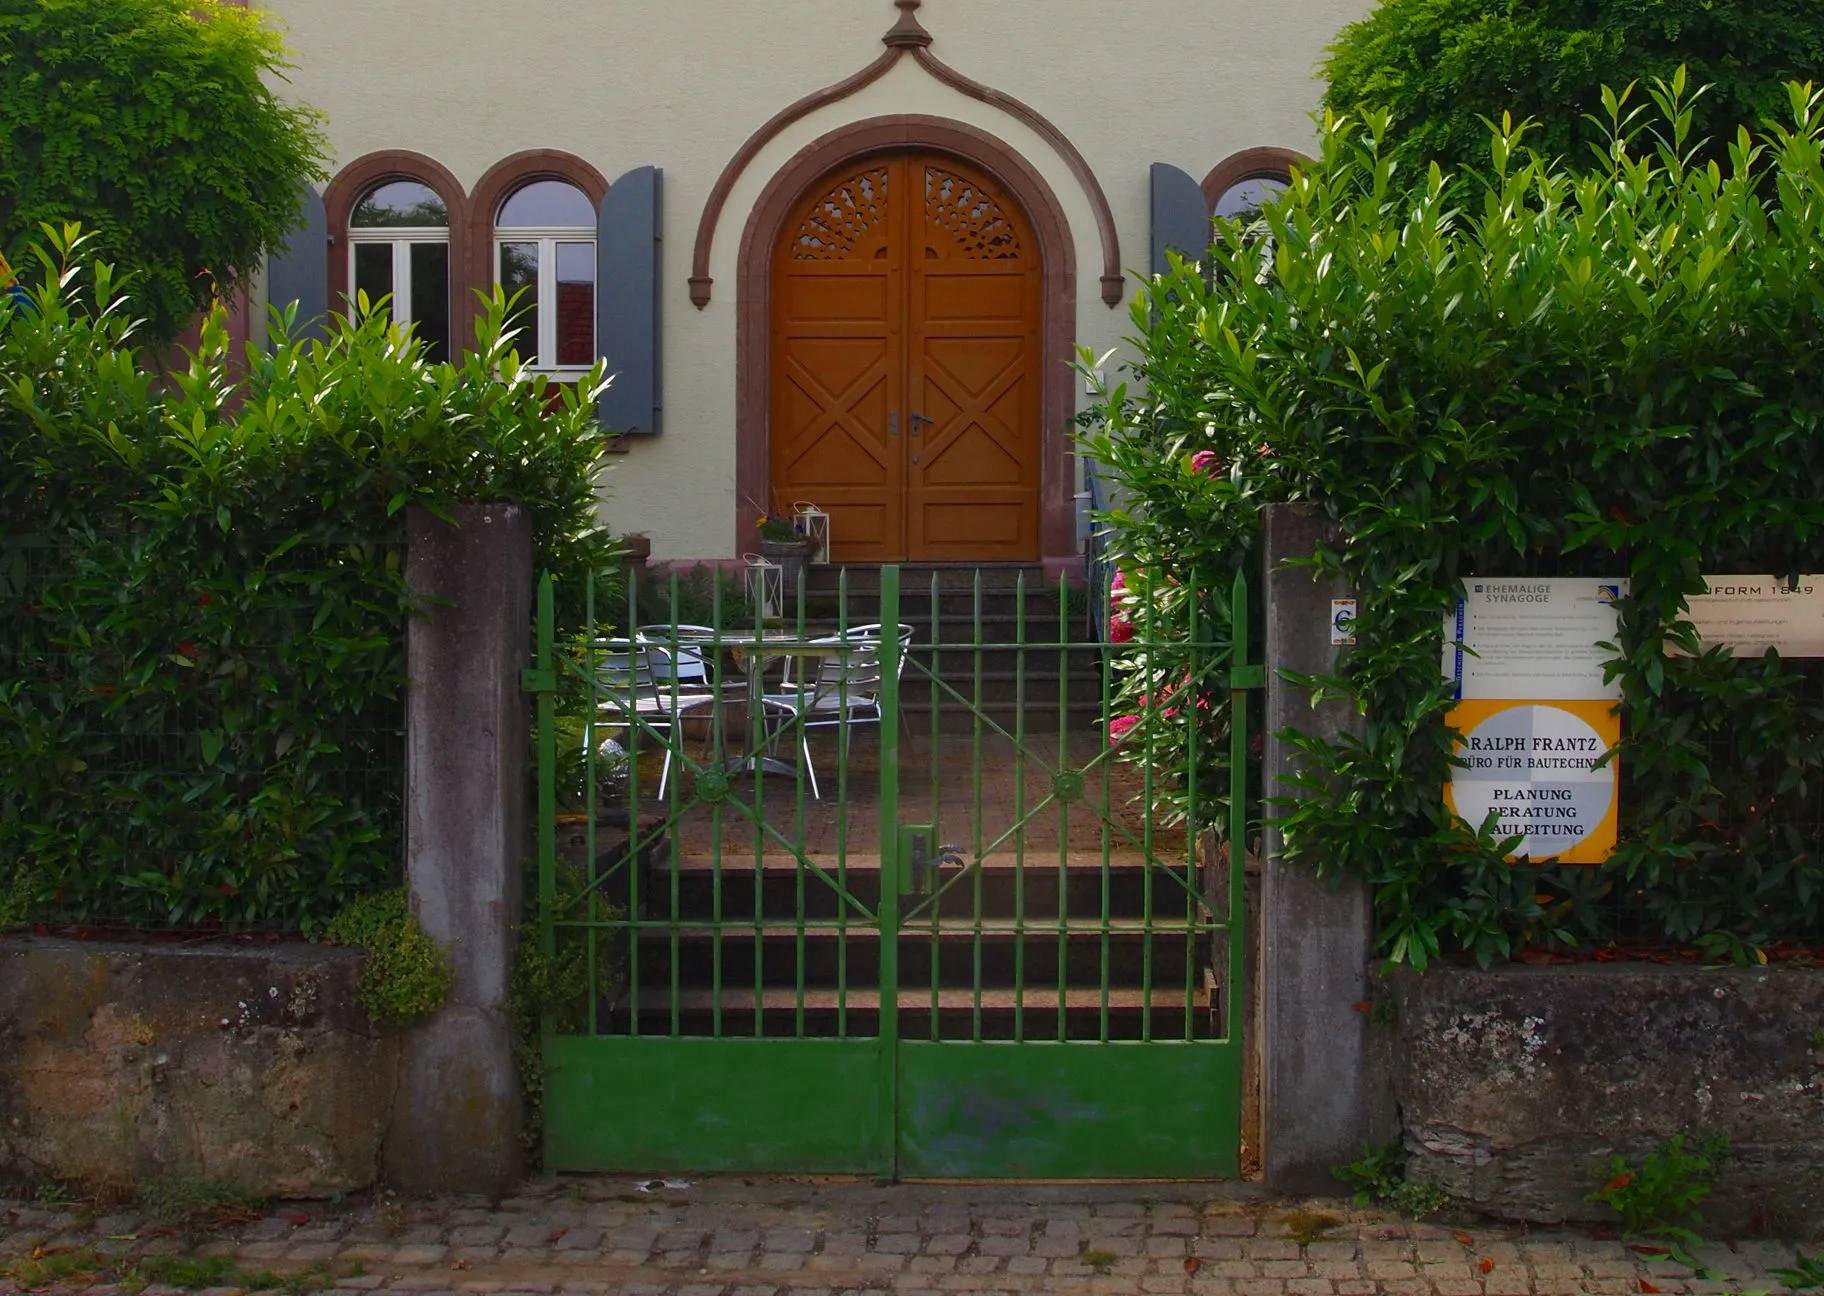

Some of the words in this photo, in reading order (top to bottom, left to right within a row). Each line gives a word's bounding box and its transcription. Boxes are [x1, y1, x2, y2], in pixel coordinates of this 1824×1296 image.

[1486, 585, 1552, 593] EHEMALIGE
[1772, 586, 1814, 595] 1849
[1486, 594, 1549, 603] SYNAGOGE
[1335, 609, 1351, 632] 6
[1471, 737, 1525, 751] RALPH
[1532, 737, 1598, 751] FRANTZ
[1498, 755, 1522, 768] FÜR
[1493, 789, 1572, 800] PLANUNG
[1480, 824, 1584, 836] AULEITUNG
